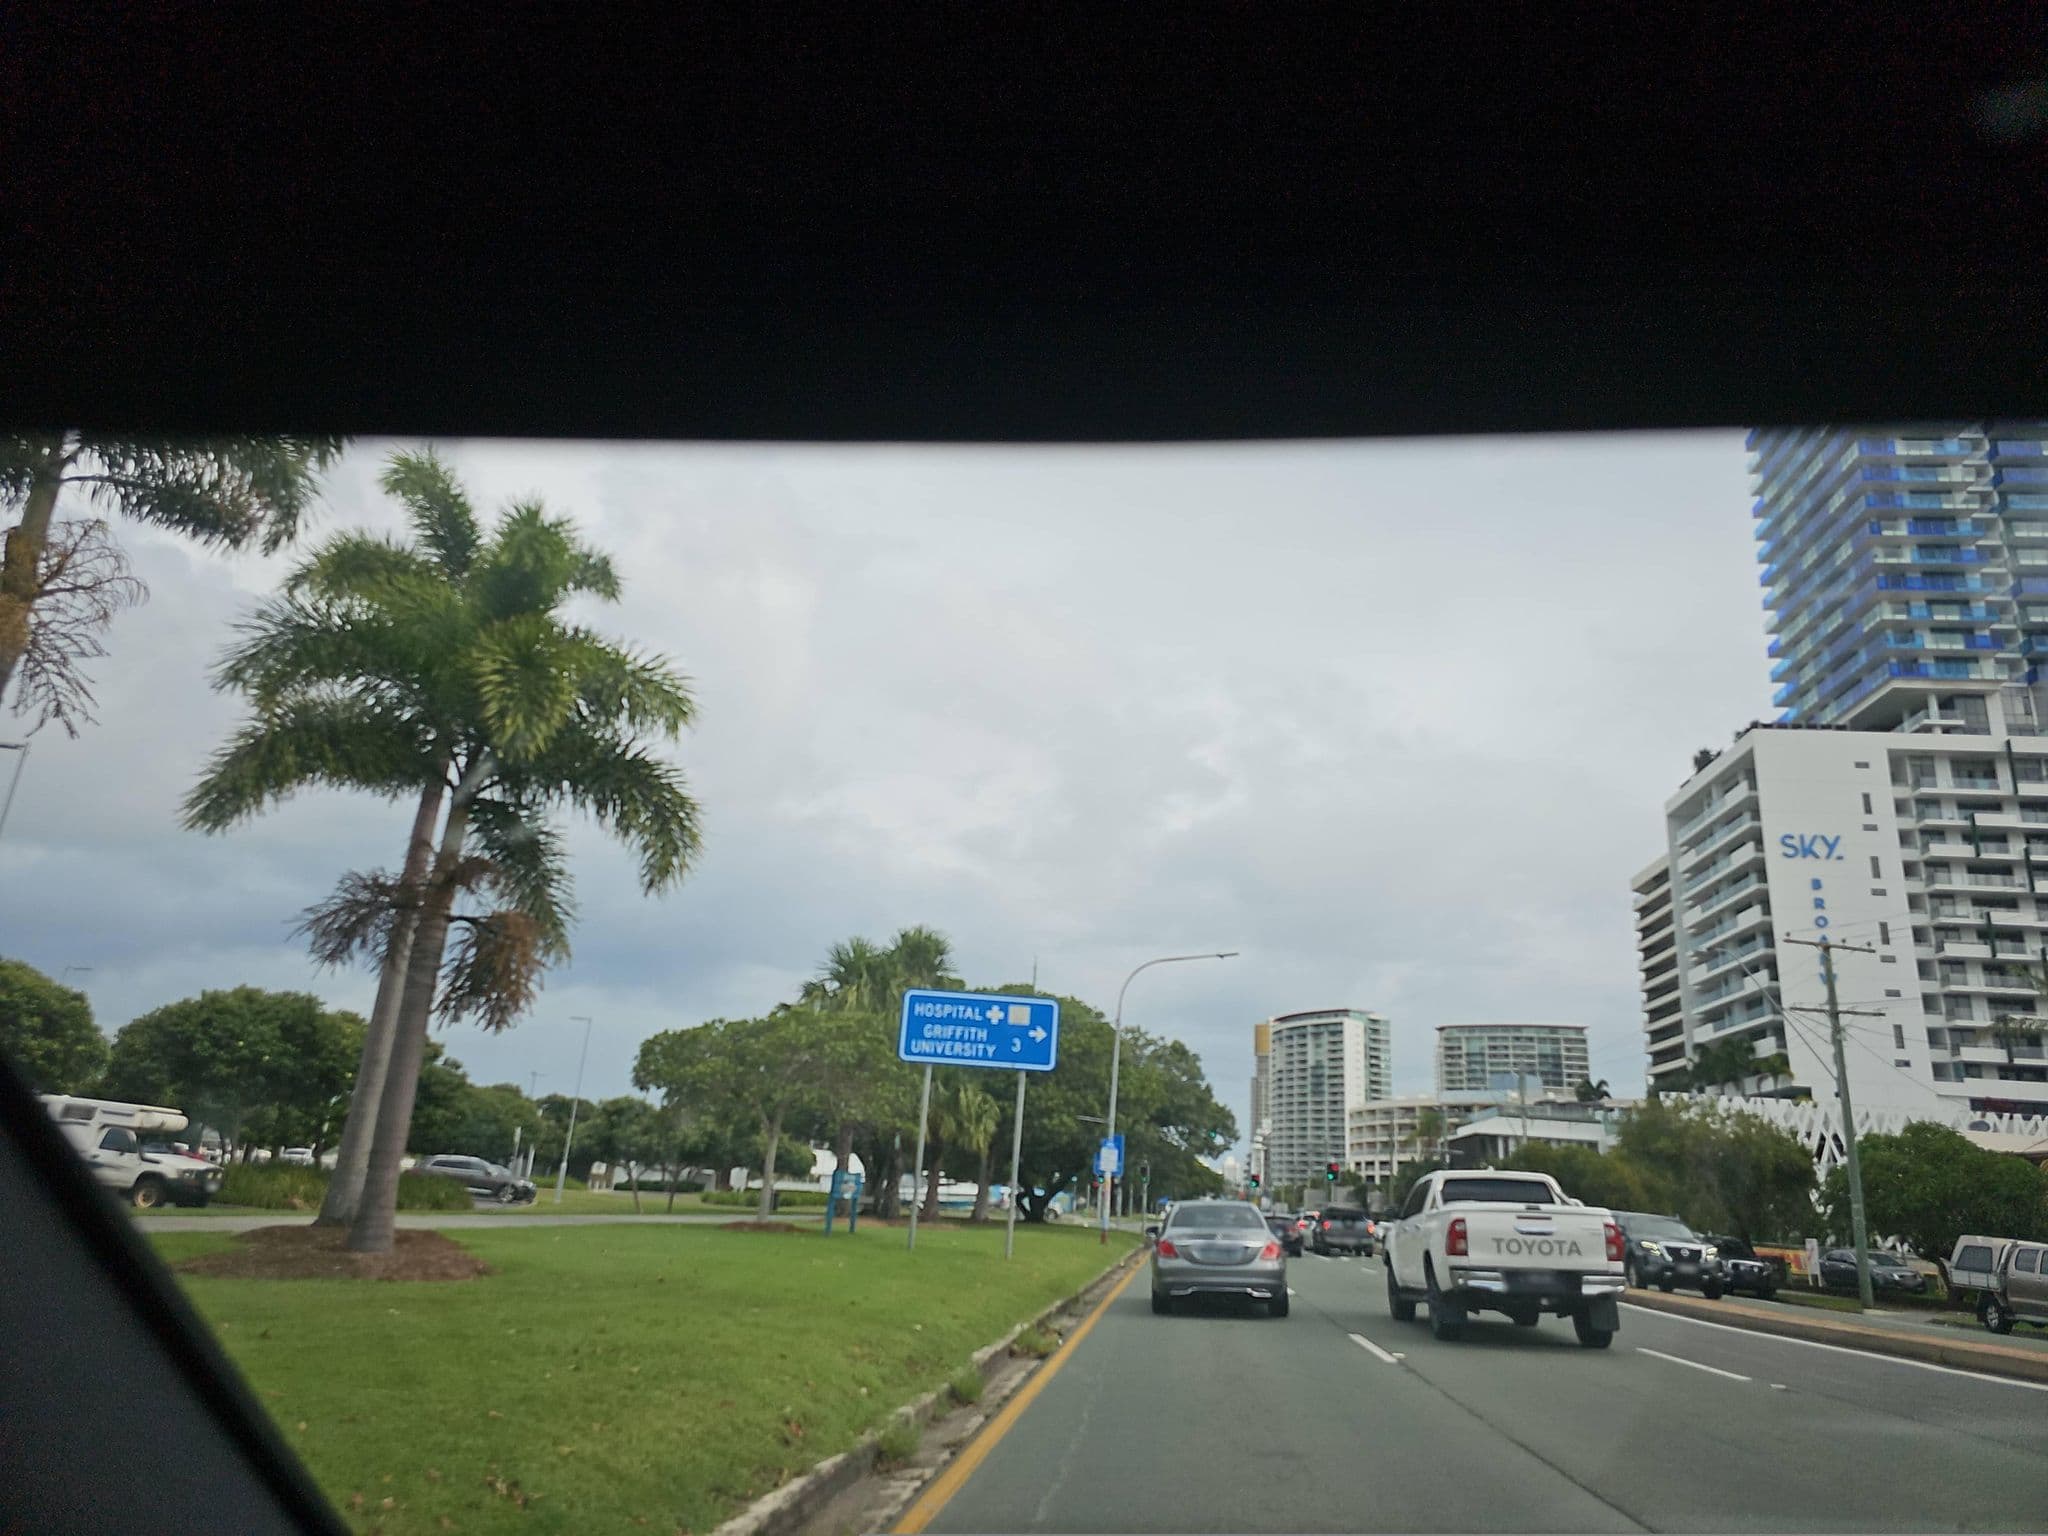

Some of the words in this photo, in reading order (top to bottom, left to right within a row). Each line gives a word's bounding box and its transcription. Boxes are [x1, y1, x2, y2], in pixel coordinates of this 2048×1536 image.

[914, 1002, 983, 1021] HOSPITAL
[923, 1024, 988, 1041] GRIFFITH
[911, 1039, 997, 1058] UNIVERSITY
[1011, 1037, 1021, 1052] 3
[1491, 1237, 1583, 1256] TOYOTA
